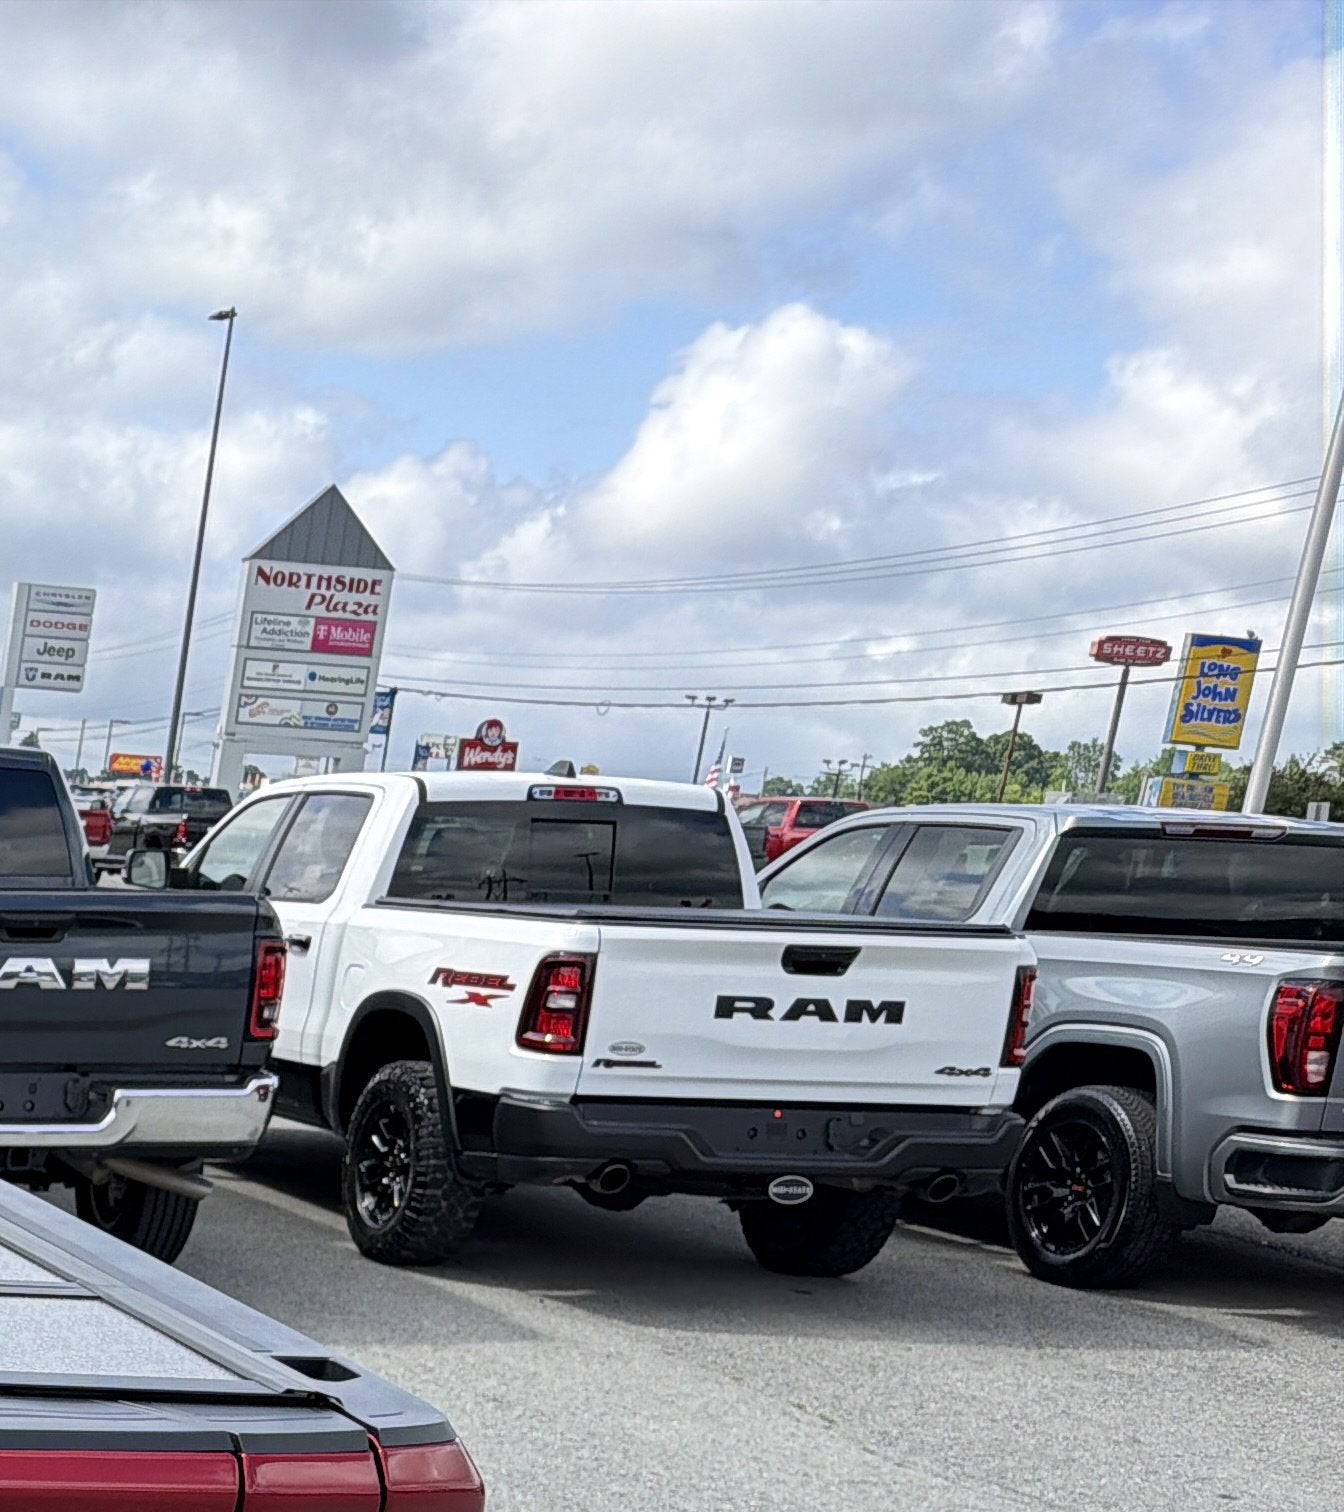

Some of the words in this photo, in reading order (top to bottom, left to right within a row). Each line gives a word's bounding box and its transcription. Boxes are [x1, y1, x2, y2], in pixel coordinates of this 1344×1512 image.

[254, 565, 384, 596] NORTHSIDE
[305, 592, 380, 617] Plaza
[29, 619, 89, 632] DODGE
[254, 616, 292, 628] Lifeline
[260, 627, 310, 639] Addiction
[36, 641, 76, 661] Jeep
[1102, 642, 1167, 659] SHEETZ
[40, 672, 82, 682] RAM
[1199, 661, 1243, 682] LONG
[427, 967, 517, 991] REBEL
[714, 995, 906, 1025] RAM
[165, 1035, 229, 1049] 4x4
[934, 1066, 993, 1078] 4x4
